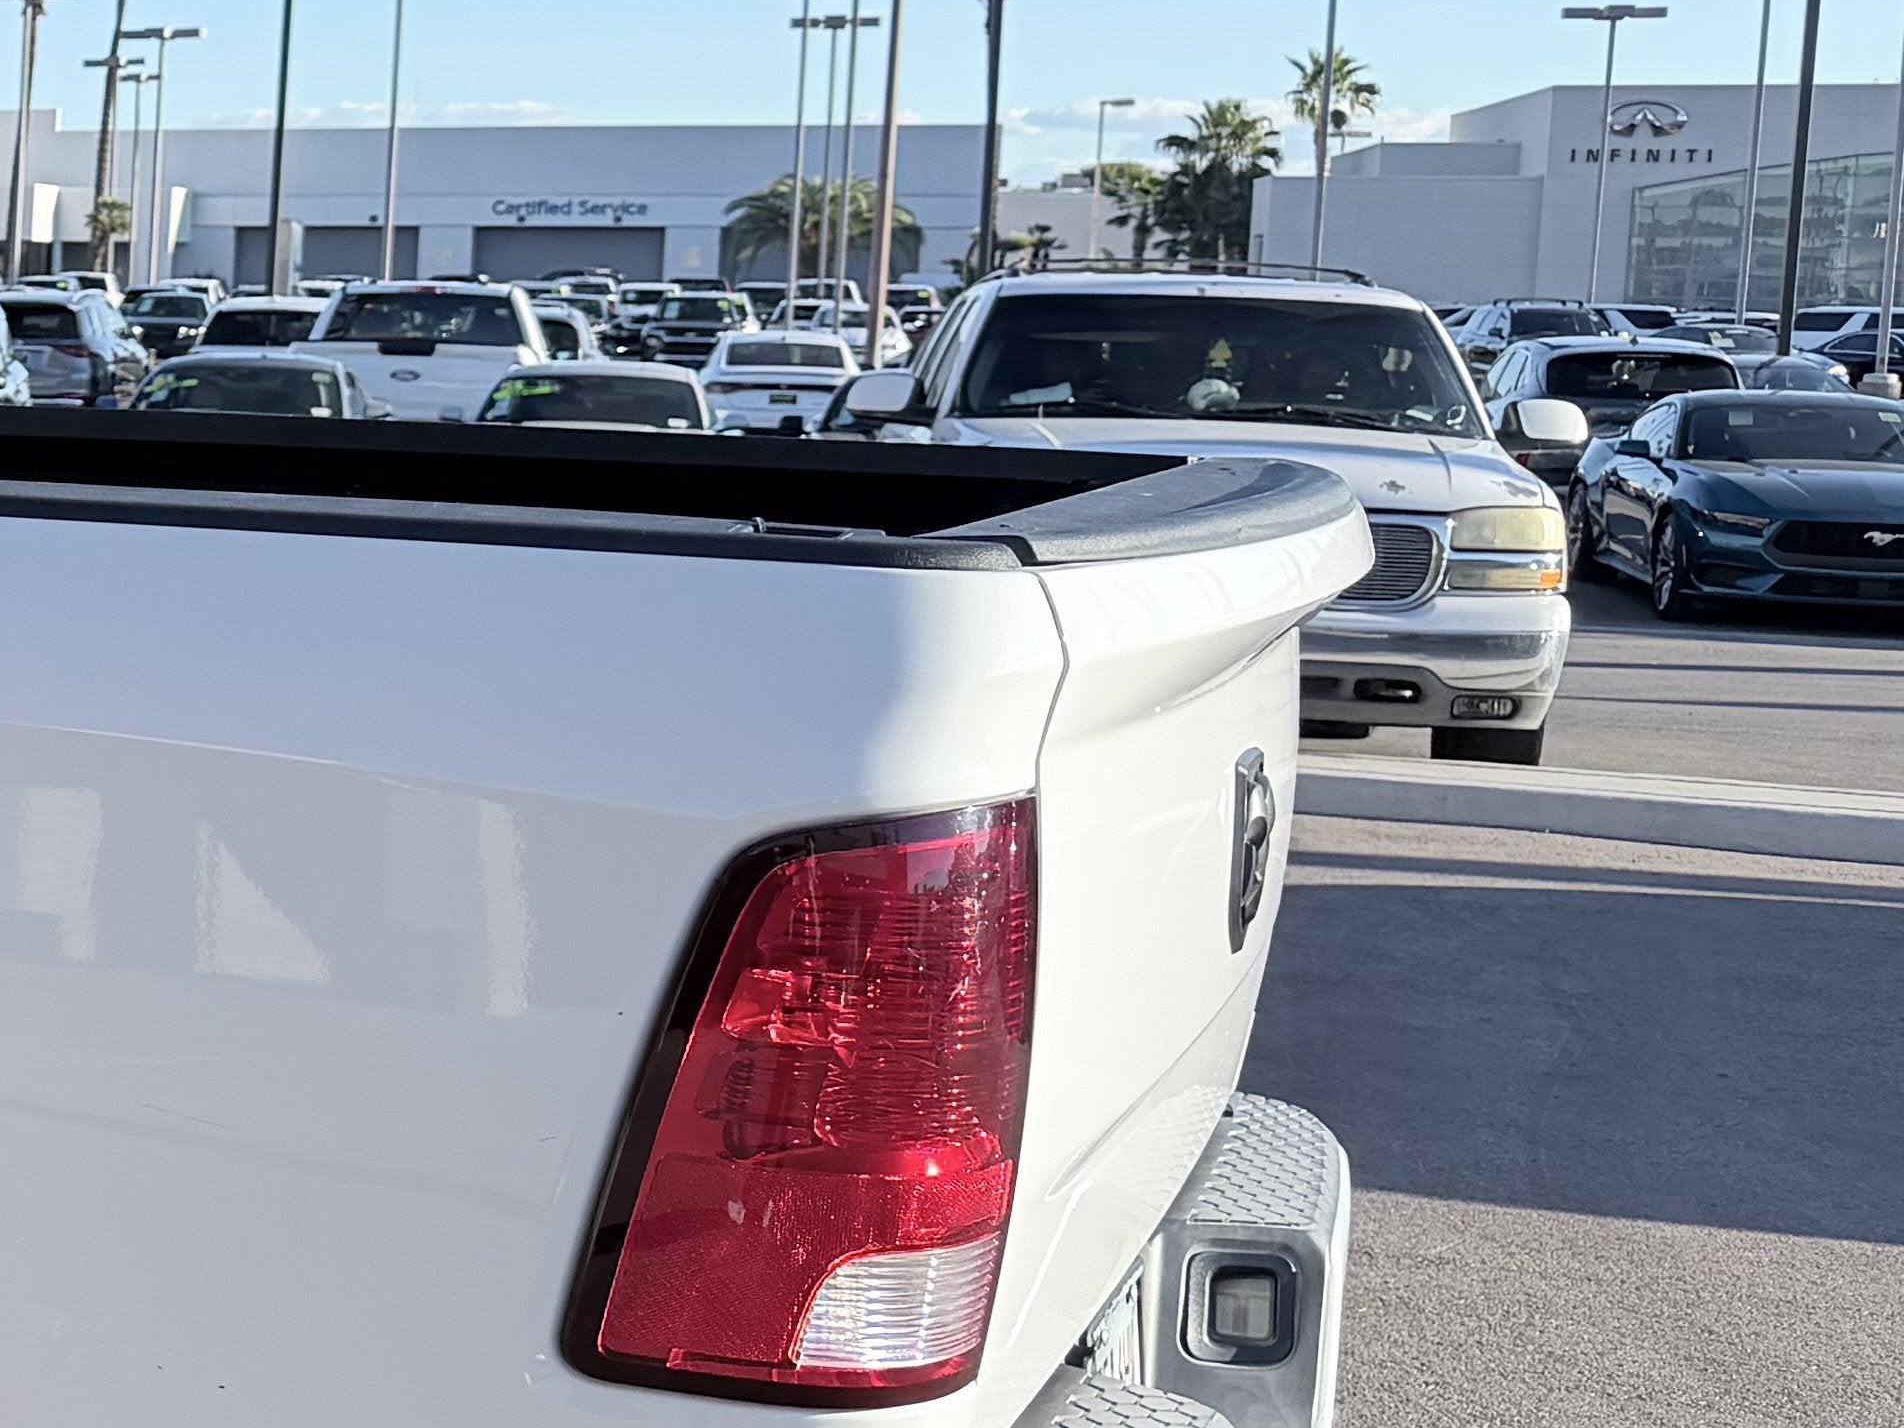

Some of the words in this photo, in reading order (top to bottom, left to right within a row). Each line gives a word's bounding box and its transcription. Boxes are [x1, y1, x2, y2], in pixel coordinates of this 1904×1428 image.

[1570, 148, 1713, 163] INFINITI
[491, 199, 572, 216] Certified
[578, 199, 648, 216] Service
